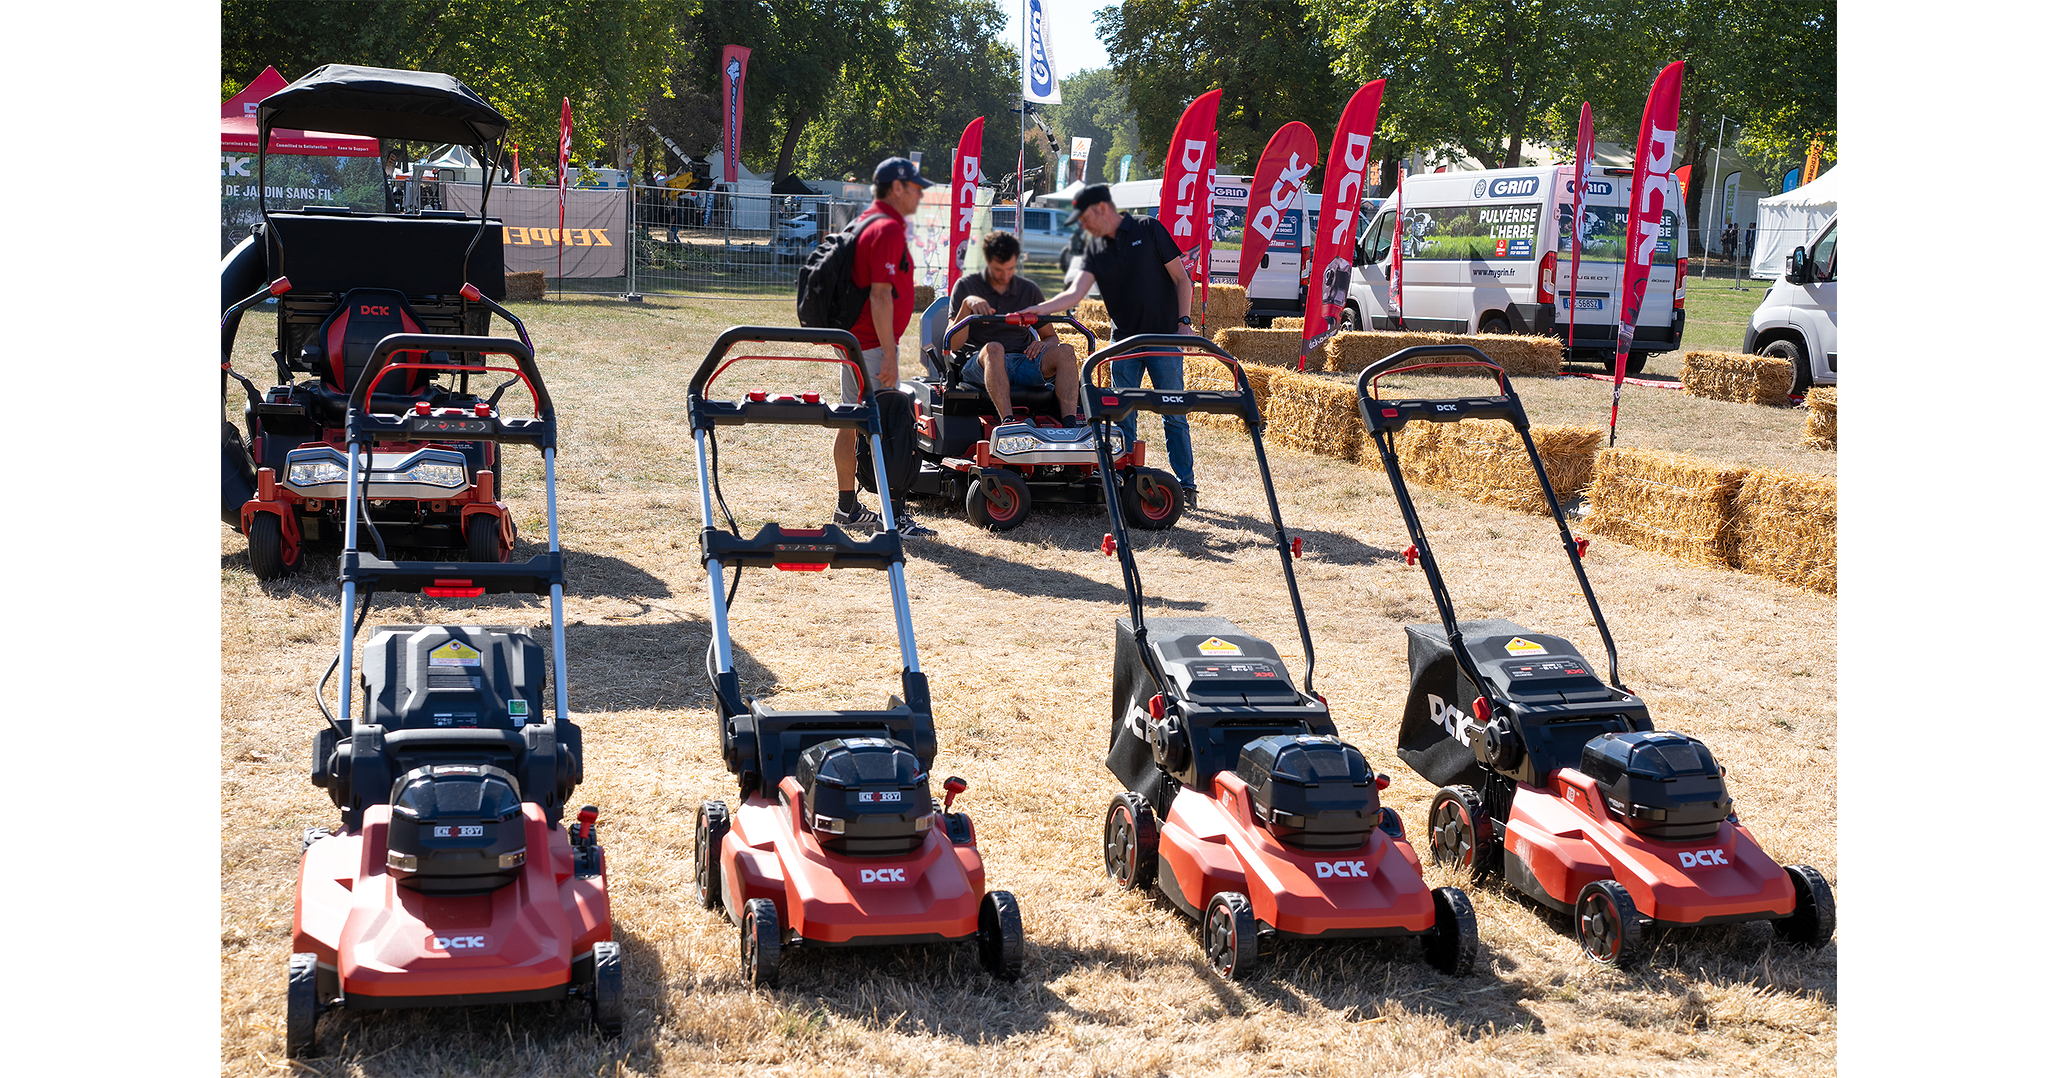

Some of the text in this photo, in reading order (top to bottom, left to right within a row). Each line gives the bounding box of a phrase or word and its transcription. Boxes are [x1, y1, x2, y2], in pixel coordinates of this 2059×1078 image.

[226, 185, 334, 201] DE JADIN SANS FIL
[959, 155, 978, 232] DCK
[1173, 139, 1206, 237] DCK
[1215, 188, 1244, 197] GRIN
[1252, 151, 1312, 241] DCK
[1332, 132, 1371, 245] DCK
[1494, 179, 1535, 196] GRIN
[1726, 183, 1736, 218] ETESIA
[1479, 206, 1538, 224] PULVÉRISE
[1490, 224, 1536, 239] L'HERBE
[1472, 268, 1516, 279] www.mygrin.fr
[361, 305, 390, 316] DCK
[1162, 395, 1184, 403] DCK
[1428, 693, 1472, 748] DCK
[1678, 848, 1729, 869] DCK
[861, 868, 906, 883] DCK
[1315, 860, 1368, 878] DCK
[433, 935, 485, 950] DCK
